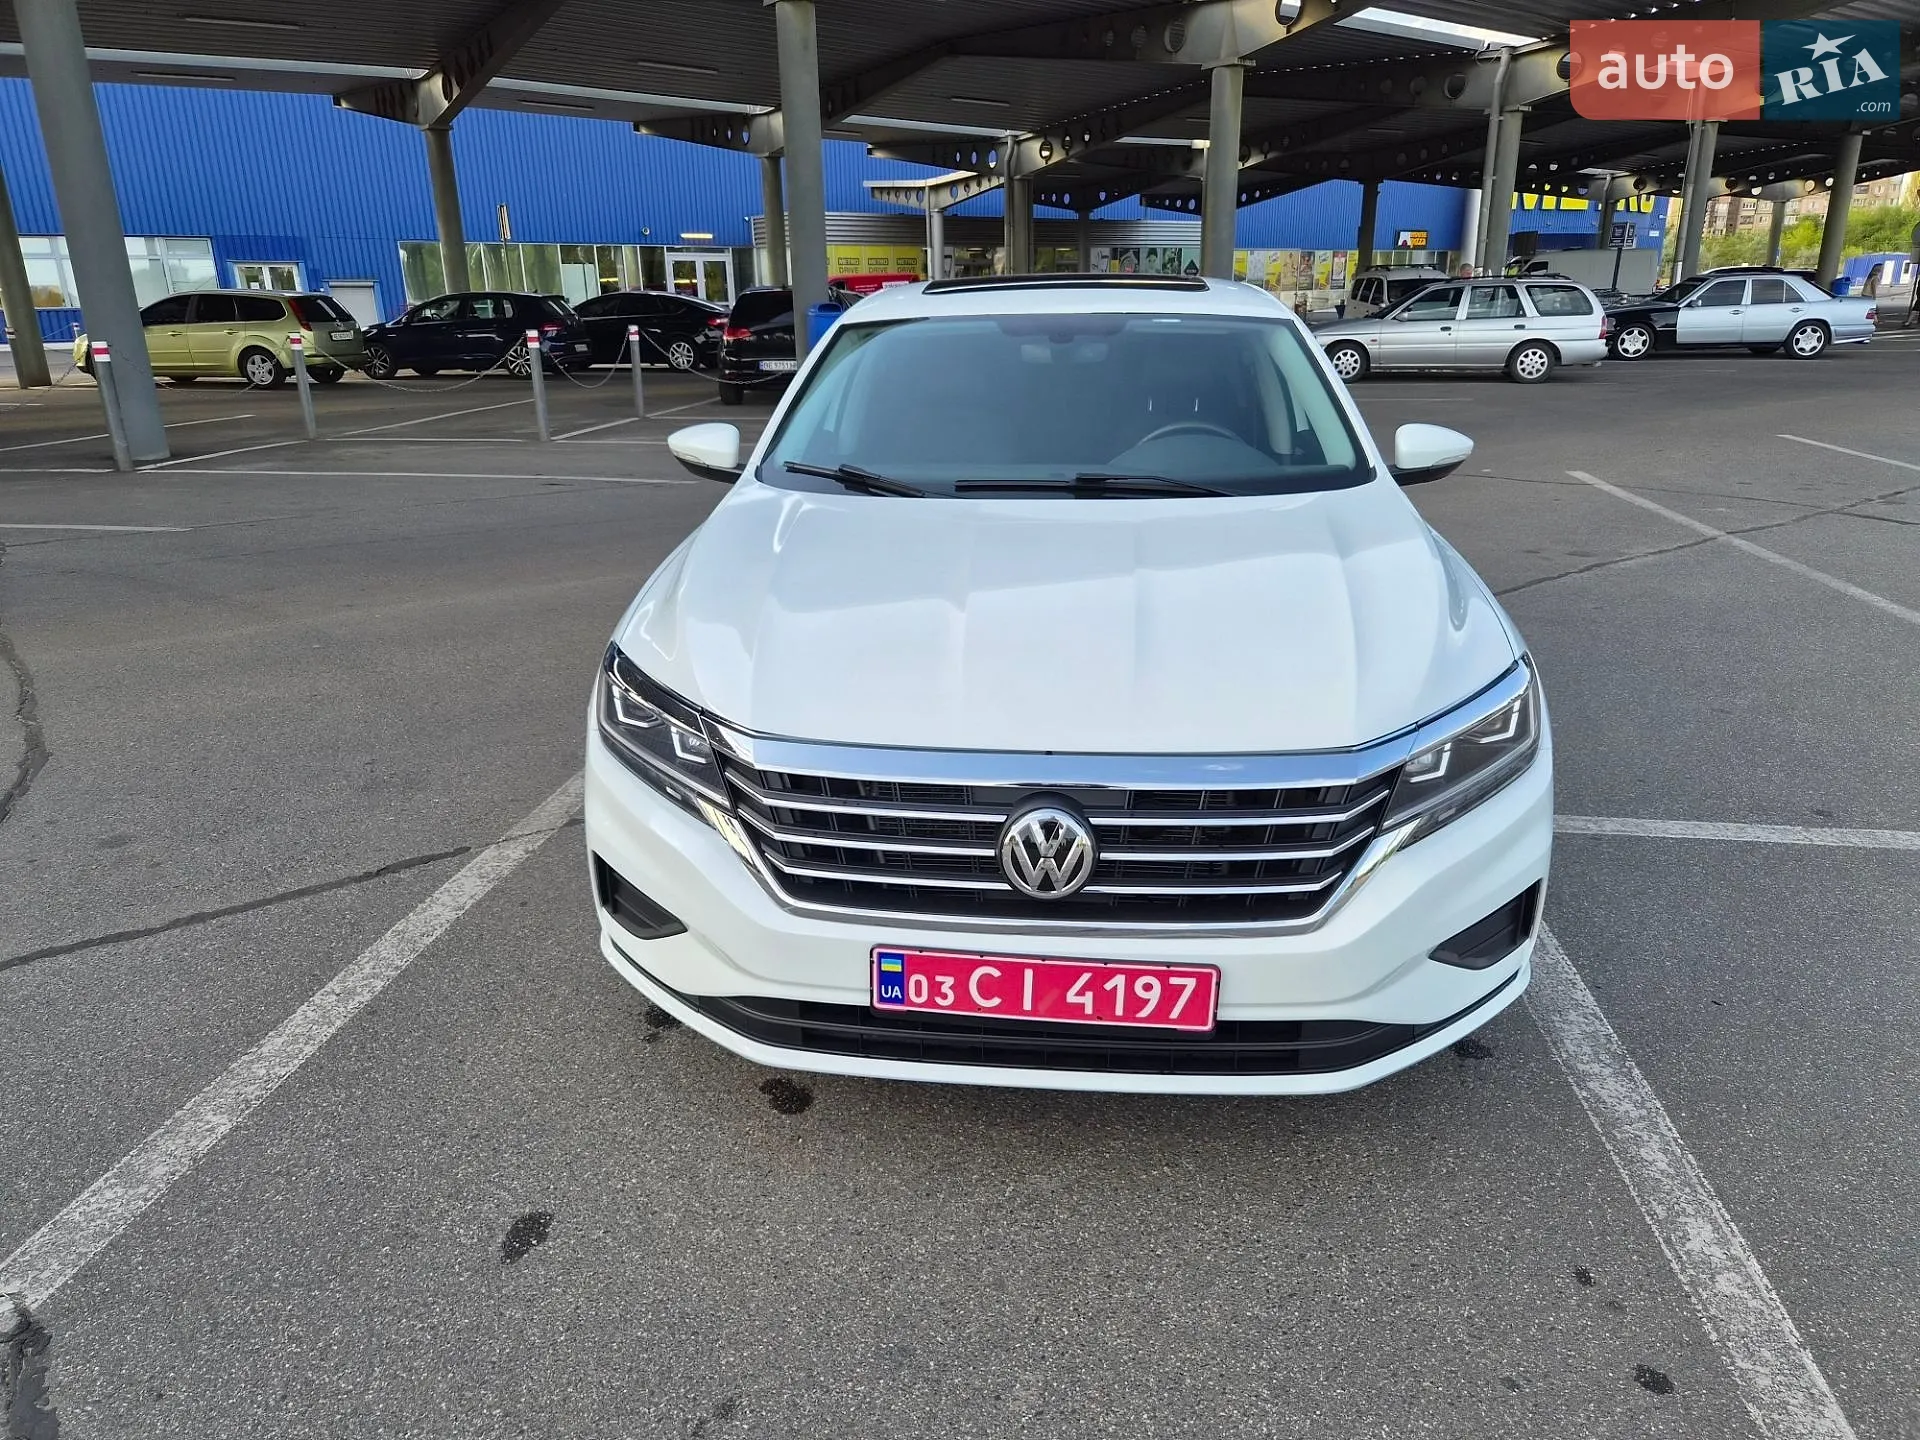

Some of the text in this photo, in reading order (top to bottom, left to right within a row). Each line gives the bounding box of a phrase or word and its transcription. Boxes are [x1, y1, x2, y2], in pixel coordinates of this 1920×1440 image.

[881, 985, 902, 999] UA
[908, 974, 955, 1006] 03
[1065, 972, 1198, 1020] 4197
